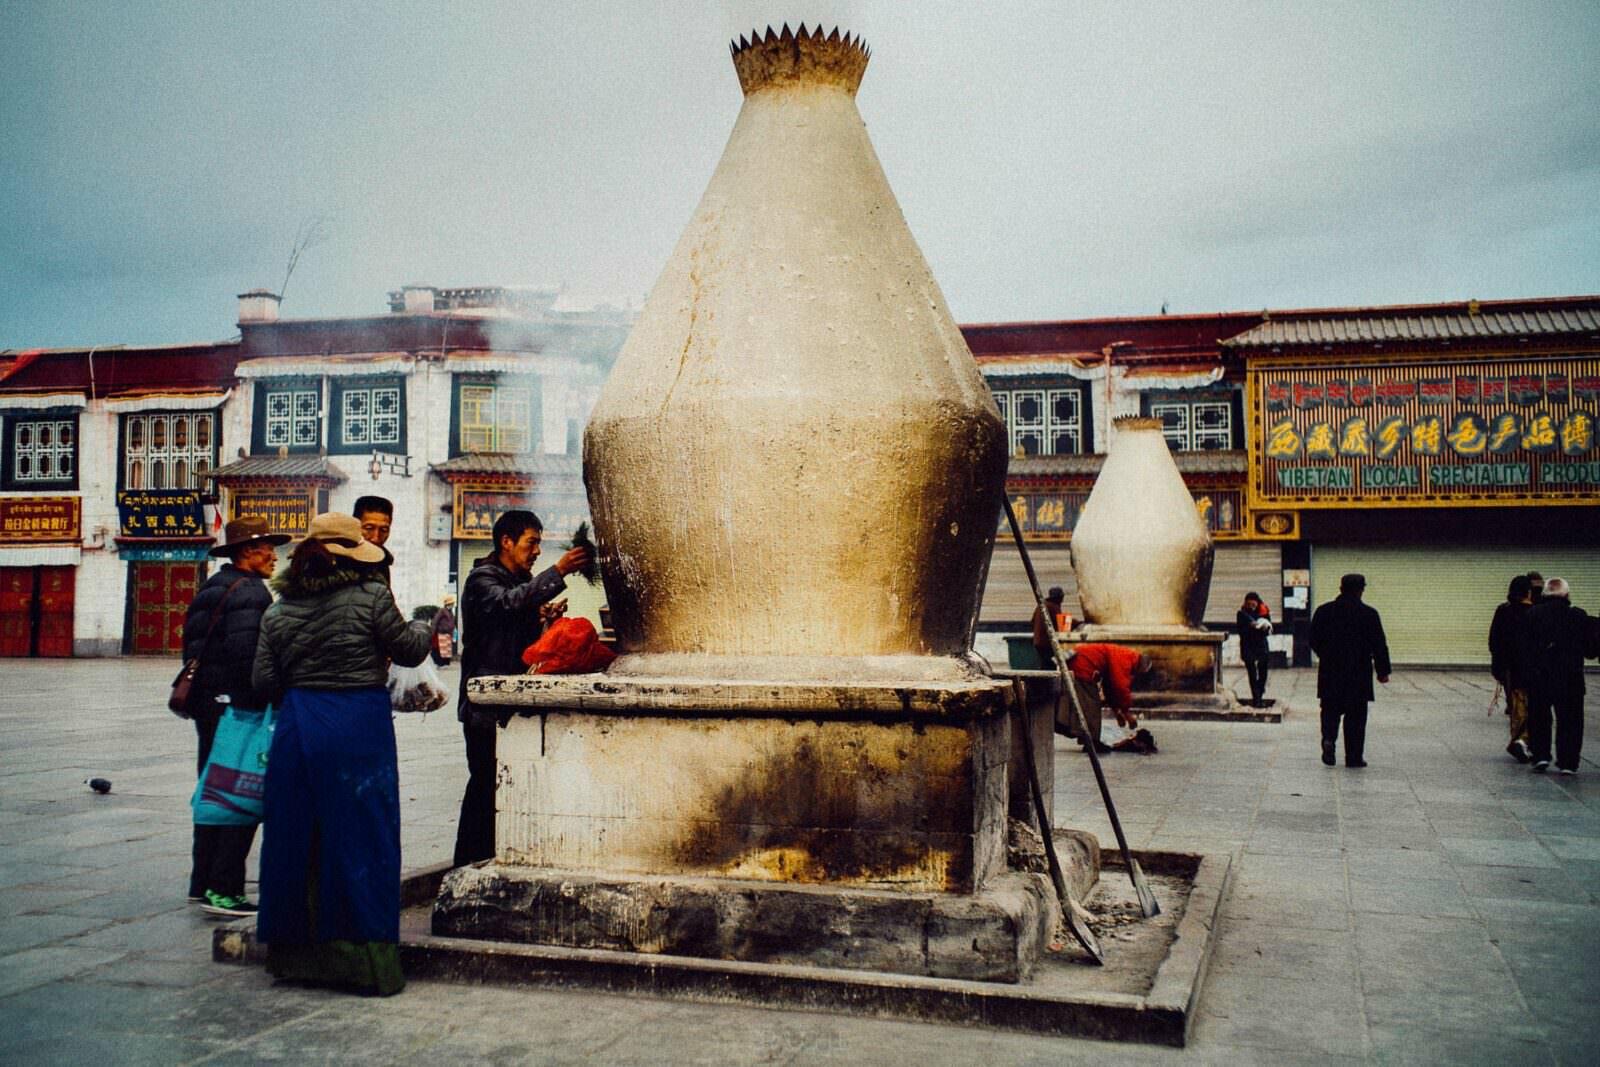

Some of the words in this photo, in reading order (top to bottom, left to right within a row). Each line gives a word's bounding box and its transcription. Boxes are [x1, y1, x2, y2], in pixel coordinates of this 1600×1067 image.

[1279, 467, 1350, 487] TIBETAN
[1363, 466, 1419, 486] LOCAL
[1429, 464, 1529, 486] SPECIALITY
